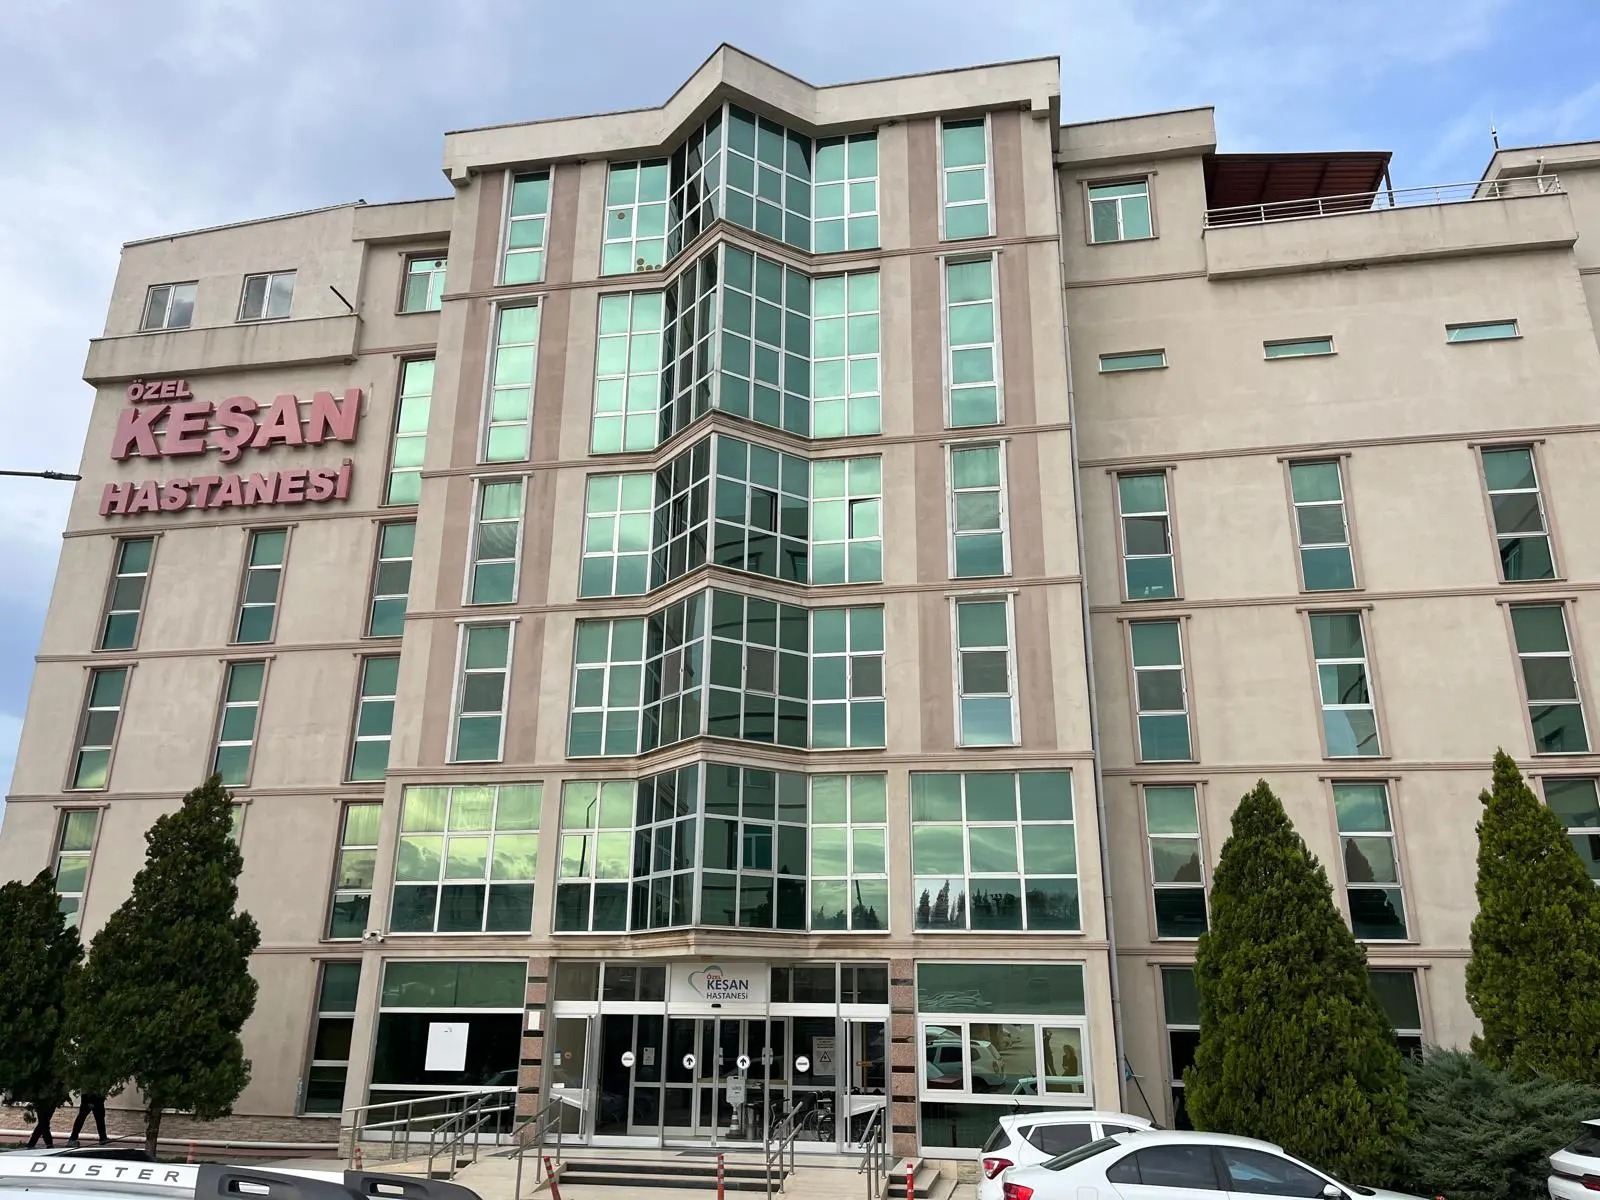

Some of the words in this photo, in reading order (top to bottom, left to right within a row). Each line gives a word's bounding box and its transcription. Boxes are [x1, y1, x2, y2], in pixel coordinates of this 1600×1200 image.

[127, 379, 193, 402] ÖZEL
[111, 388, 362, 463] KEŞAN
[100, 458, 353, 515] HASTANESİ
[707, 979, 749, 991] KEŞAN
[30, 1162, 180, 1182] DUSTER
